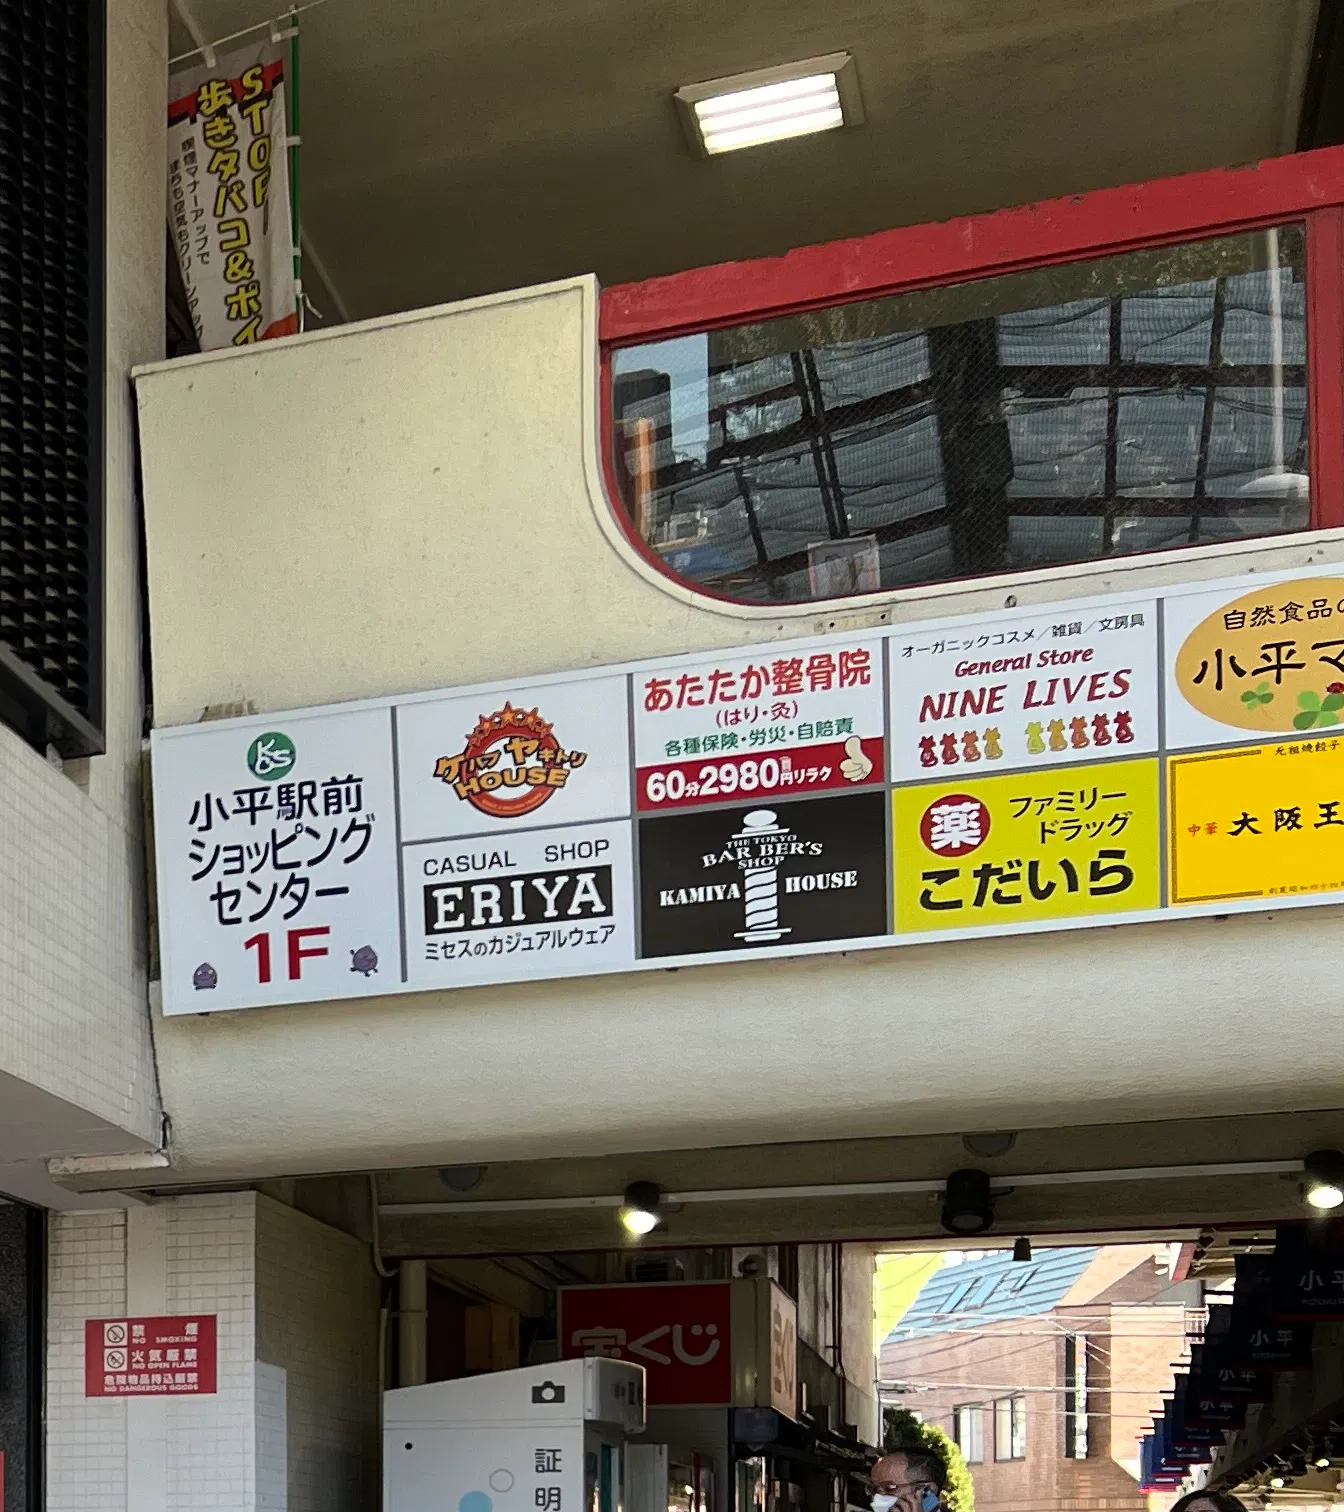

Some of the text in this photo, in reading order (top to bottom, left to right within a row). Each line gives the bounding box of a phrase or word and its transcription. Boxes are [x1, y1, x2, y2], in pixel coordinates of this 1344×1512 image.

[643, 647, 871, 713] あたたか整骨院
[955, 647, 1095, 678] General Store
[918, 668, 1133, 723] NINE LIVES
[664, 716, 854, 757] 各種保険・労災・自賠責
[188, 774, 364, 832] 小平駅前
[453, 768, 570, 800] HOUSE
[1009, 787, 1127, 819] ファミリー
[930, 801, 982, 851] 薬
[1040, 810, 1134, 845] ドラッグ
[1227, 801, 1344, 837] 大阪王
[188, 816, 376, 882] ショッピング
[423, 839, 611, 876] CASUAL SHOP
[752, 834, 798, 844] TOKYO
[737, 856, 785, 870] SHOP
[919, 849, 1134, 912] こだいら
[209, 873, 349, 926] センター
[431, 871, 608, 930] ERIYA
[660, 870, 858, 907] KAMIYA HOUSE
[243, 925, 331, 984] 1F
[424, 924, 616, 961] ミセスのカジュアルウェア
[571, 1324, 720, 1366] 宝くじ
[1248, 1329, 1294, 1347] 小平
